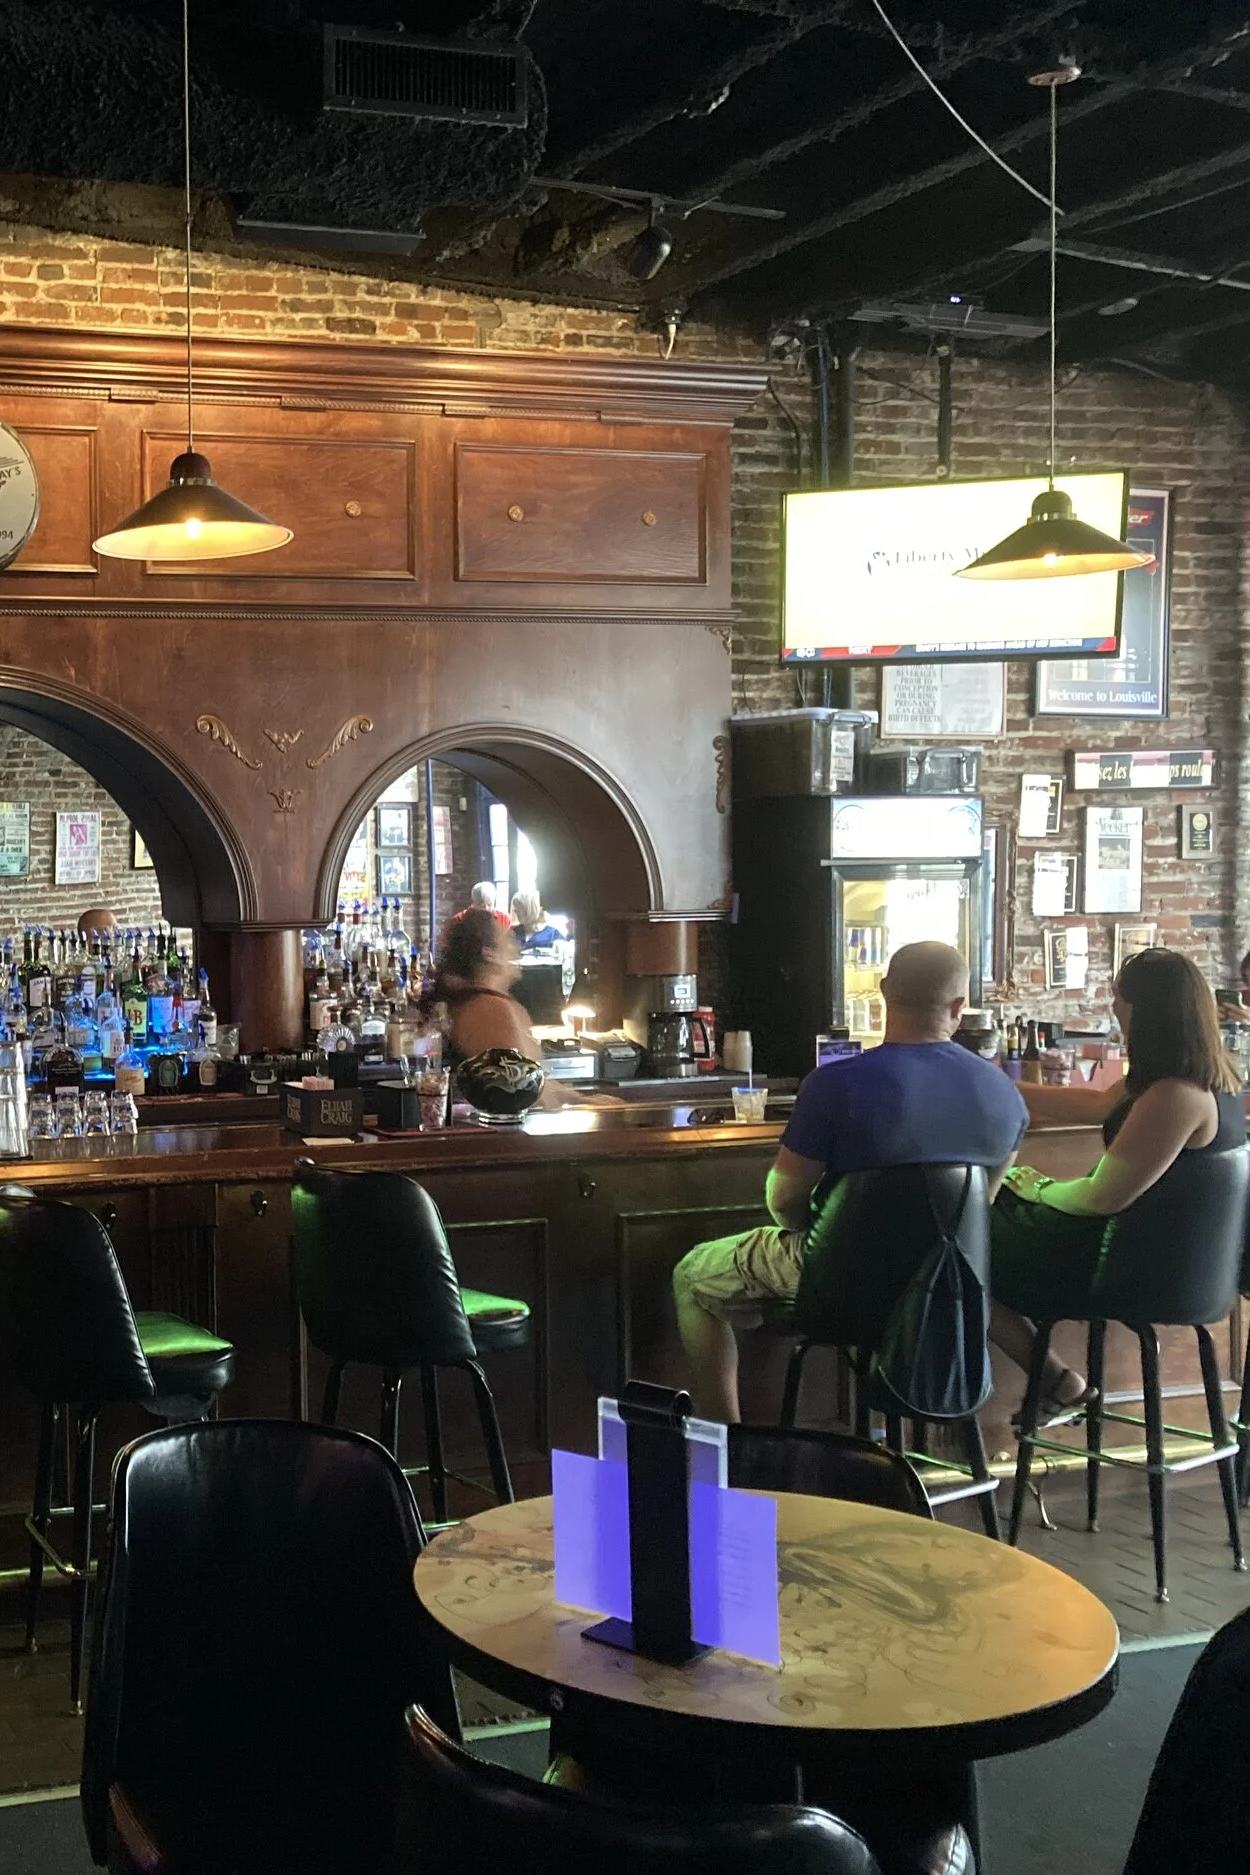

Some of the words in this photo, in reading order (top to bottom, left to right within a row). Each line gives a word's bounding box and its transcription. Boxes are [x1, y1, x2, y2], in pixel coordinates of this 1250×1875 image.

[1048, 689, 1094, 703] Welcome
[1096, 689, 1107, 703] to
[1109, 690, 1158, 704] Louisville
[1114, 761, 1127, 780] les
[320, 1099, 353, 1112] ELIJAH
[320, 1110, 353, 1125] CRAIG
